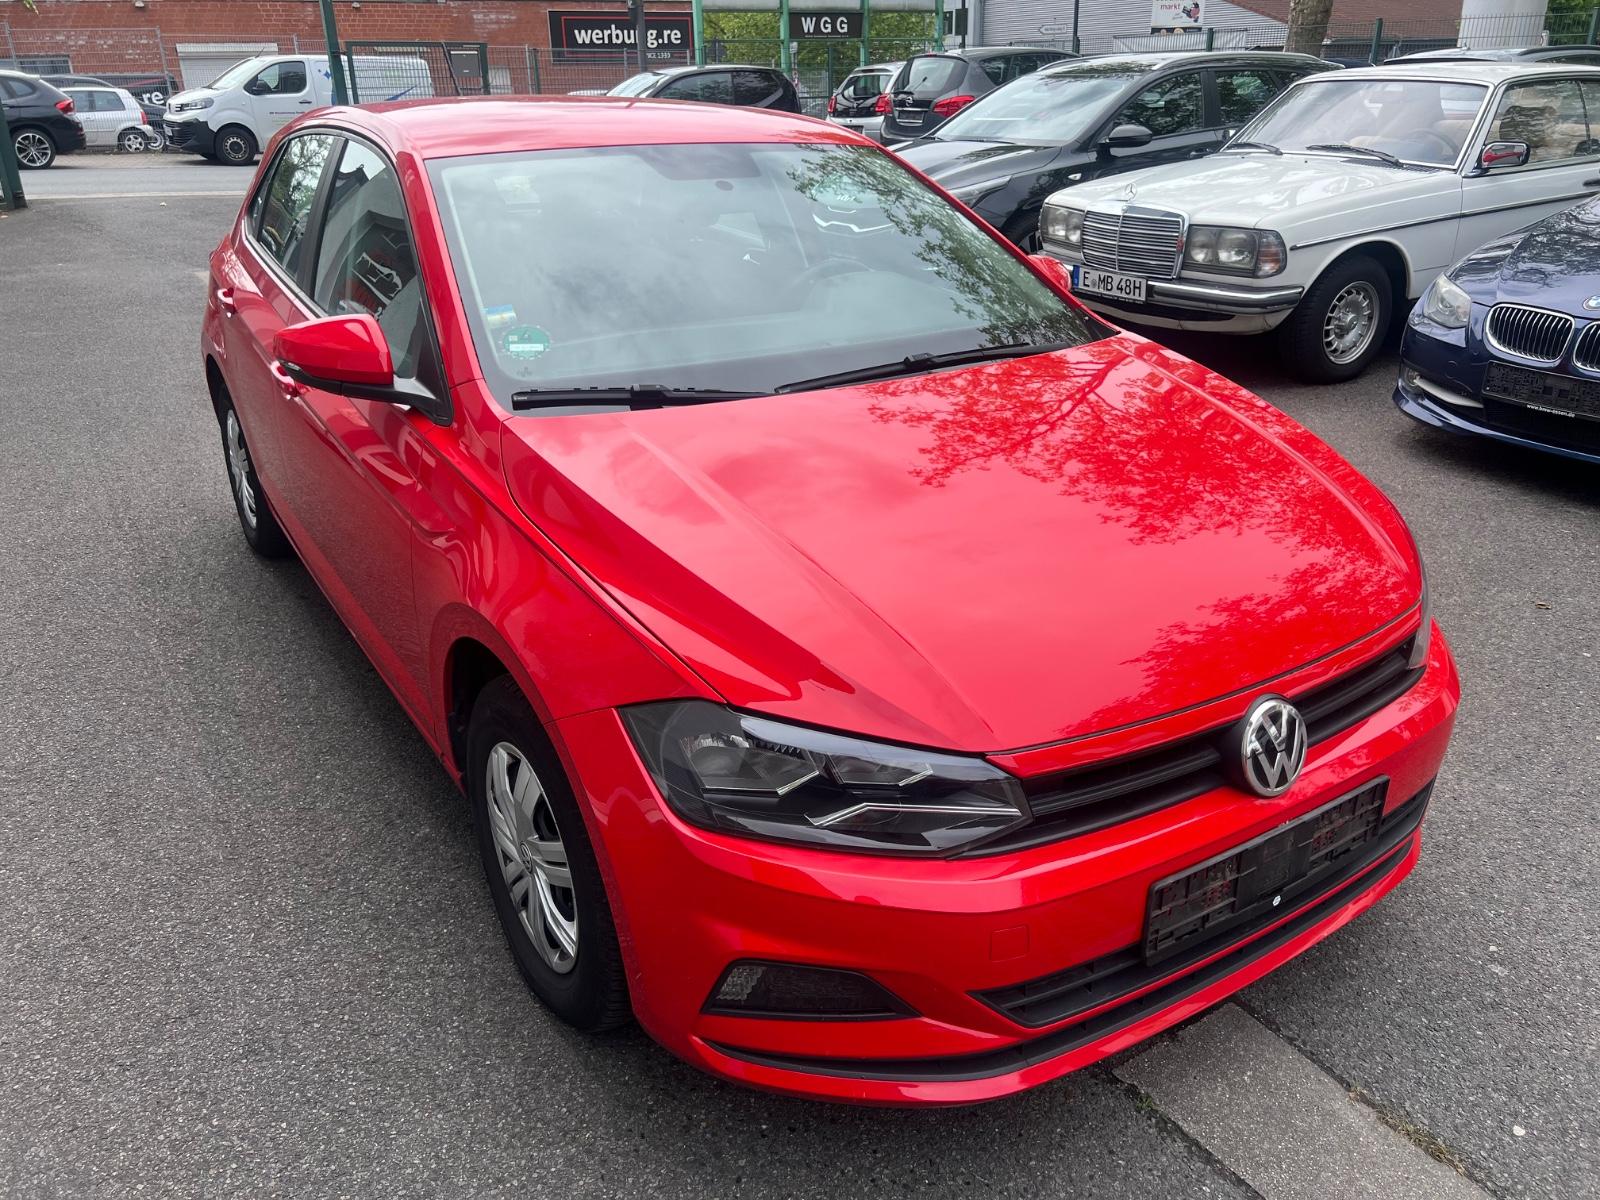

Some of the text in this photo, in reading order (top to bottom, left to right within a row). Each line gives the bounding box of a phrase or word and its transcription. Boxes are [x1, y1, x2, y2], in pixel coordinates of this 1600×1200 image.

[1083, 271, 1142, 297] E MB 48H
